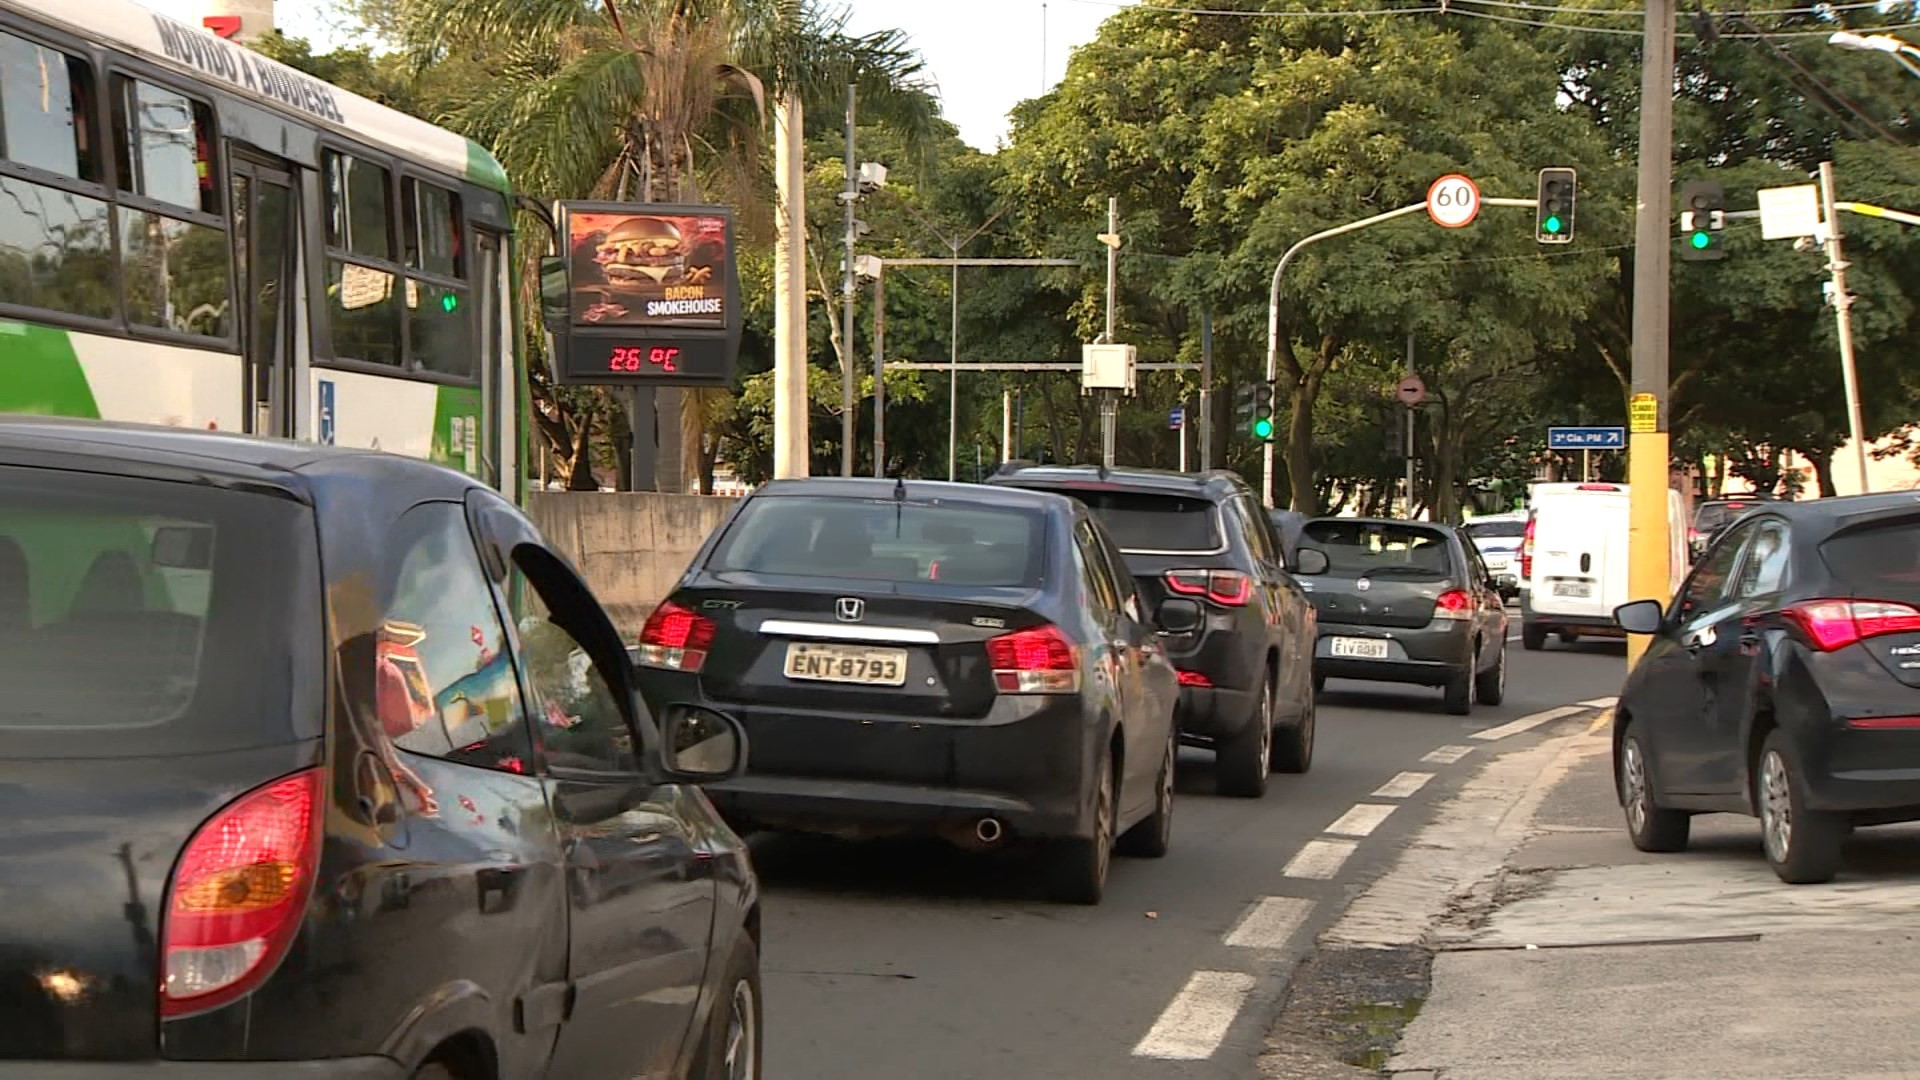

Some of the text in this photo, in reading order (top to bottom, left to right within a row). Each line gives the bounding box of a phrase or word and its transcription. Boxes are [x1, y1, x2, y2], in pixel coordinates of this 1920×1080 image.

[152, 14, 238, 82] MOVIDO
[238, 50, 258, 93] A
[251, 55, 345, 124] BIODIESEL
[1437, 186, 1470, 207] 60
[665, 286, 704, 300] BACON
[647, 300, 722, 316] SMOKEHOUSE
[1586, 433, 1602, 442] PM
